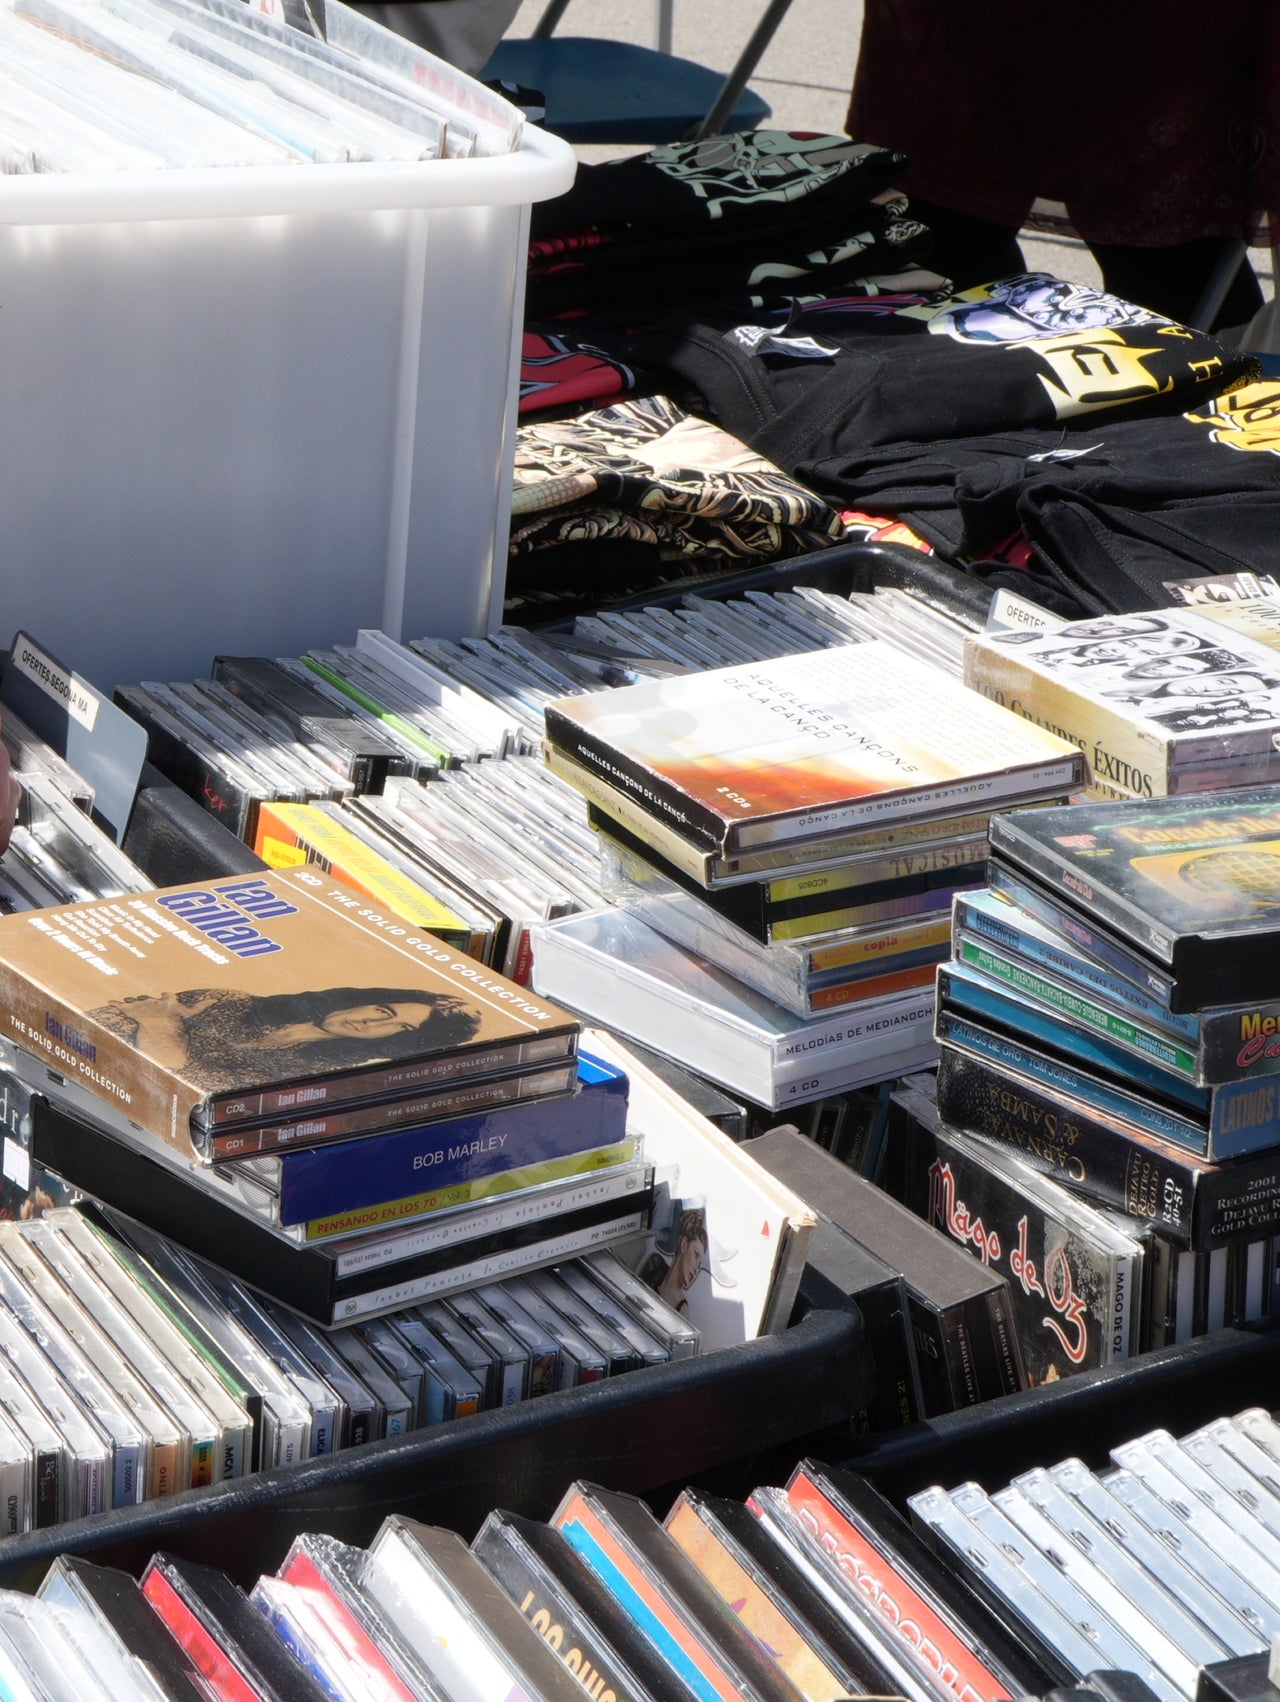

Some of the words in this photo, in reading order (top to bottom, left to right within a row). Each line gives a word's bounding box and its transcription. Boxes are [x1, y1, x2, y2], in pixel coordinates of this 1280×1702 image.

[21, 650, 51, 682] OFERTES
[722, 677, 749, 691] DE
[748, 691, 771, 705] LA
[748, 672, 835, 723] AQUELLES
[831, 722, 922, 774] CANÇONS
[577, 744, 612, 772] AQUELLES
[611, 766, 643, 796] CANÇONS
[643, 787, 653, 801] DE
[652, 796, 663, 808] LA
[1092, 741, 1153, 798] ÉXITOS
[726, 792, 752, 809] CDS
[857, 806, 875, 815] DE
[877, 792, 932, 811] CANÇONS
[934, 781, 993, 801] AQUELLES
[841, 809, 856, 818] LA
[210, 879, 300, 920] Ian
[798, 878, 829, 891] 4CD805
[26, 913, 52, 933] Over
[52, 931, 84, 955] Hours
[155, 890, 285, 960] Gillan
[863, 934, 899, 952] copia
[193, 942, 230, 966] Tracks
[294, 871, 324, 887] 2CD
[326, 890, 361, 910] THE
[358, 906, 407, 937] SOLID
[405, 936, 452, 964] GOLD
[450, 962, 553, 1021] COLLECTION
[824, 992, 834, 1003] 4
[834, 990, 849, 1002] CD
[10, 1015, 26, 1034] THE
[27, 1026, 53, 1051] SOLID
[54, 1045, 77, 1068] GOLD
[79, 1061, 132, 1105] COLLECTION
[785, 1033, 844, 1057] MELODÍAS
[846, 1027, 862, 1039] DE
[951, 1020, 987, 1047] LATINOS
[1001, 1042, 1022, 1061] ORO
[1028, 1054, 1048, 1075] TOM
[1046, 1062, 1079, 1088] JONES
[225, 1102, 246, 1115] CD2
[277, 1092, 296, 1108] Ian
[297, 1086, 327, 1103] Gillan
[388, 1073, 404, 1083] THE
[405, 1068, 430, 1080] SOLID
[431, 1063, 454, 1075] GOLD
[456, 1054, 505, 1072] COLLECTION
[788, 1085, 798, 1095] 4
[802, 1079, 819, 1092] CD
[225, 1139, 245, 1151] CD1
[277, 1126, 295, 1142] Ian
[297, 1120, 327, 1136] Gillan
[455, 1088, 505, 1107] COLLECTION
[987, 1083, 1060, 1136] SAMBA
[412, 1150, 446, 1171] BOB
[448, 1133, 510, 1160] MARLEY
[1127, 1151, 1143, 1216] DEJAVU
[1137, 1161, 1151, 1216] RETRO
[1146, 1168, 1159, 1219] GOLD
[316, 1210, 379, 1235] PENSANDO
[381, 1206, 398, 1220] EN
[398, 1201, 421, 1217] LOS
[422, 1196, 438, 1209] 70
[1210, 1218, 1247, 1236] GOLD
[1010, 1214, 1045, 1299] de
[1116, 1272, 1125, 1314] MAGO
[1114, 1314, 1124, 1333] DE
[959, 1340, 970, 1372] BEATLES
[997, 1324, 1009, 1357] BEATLES
[1005, 1358, 1014, 1376] LIVE
[1112, 1334, 1123, 1354] OZ
